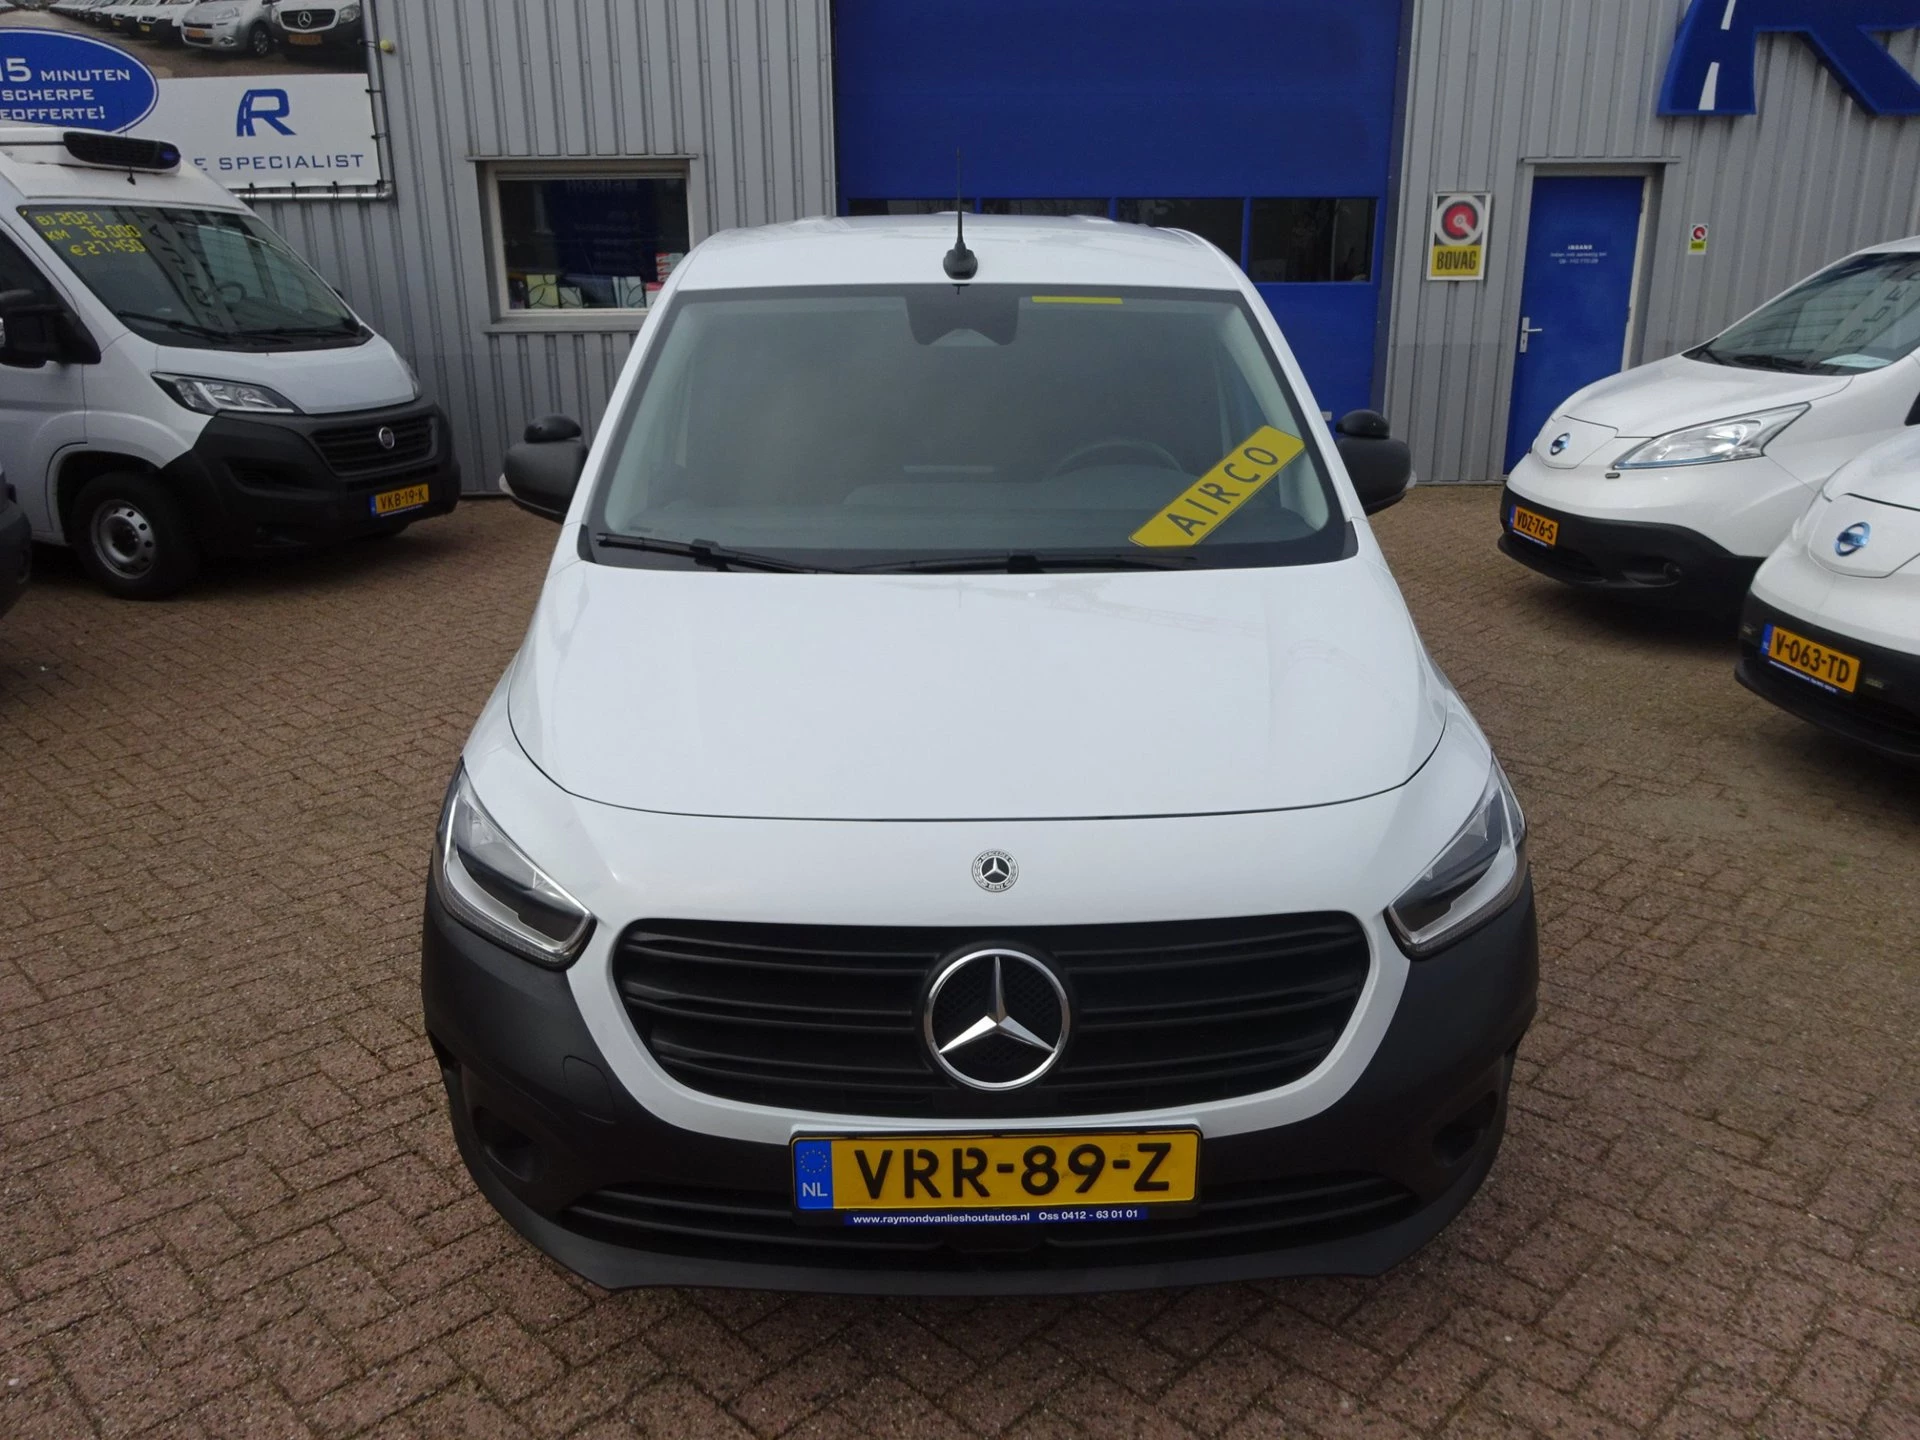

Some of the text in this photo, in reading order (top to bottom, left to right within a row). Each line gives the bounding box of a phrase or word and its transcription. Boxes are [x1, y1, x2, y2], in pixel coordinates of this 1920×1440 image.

[40, 69, 131, 82] MINUTEN
[2, 88, 95, 101] SCHERPE
[219, 154, 364, 171] SPECIALIST
[44, 229, 71, 241] KM
[1436, 249, 1478, 271] BOVAG
[380, 487, 426, 510] VKB-19-K
[1166, 446, 1279, 537] AIRCO
[1776, 631, 1851, 684] V-063-TD
[854, 1142, 1173, 1200] VRR-89-Z
[801, 1182, 828, 1198] NL
[852, 1212, 1030, 1225] www.raymondvanlieshoutautos.nl
[1038, 1211, 1059, 1220] Oss
[1061, 1210, 1086, 1220] 0412
[1095, 1210, 1109, 1219] 63
[1111, 1209, 1123, 1218] 01
[1126, 1209, 1138, 1218] 01
